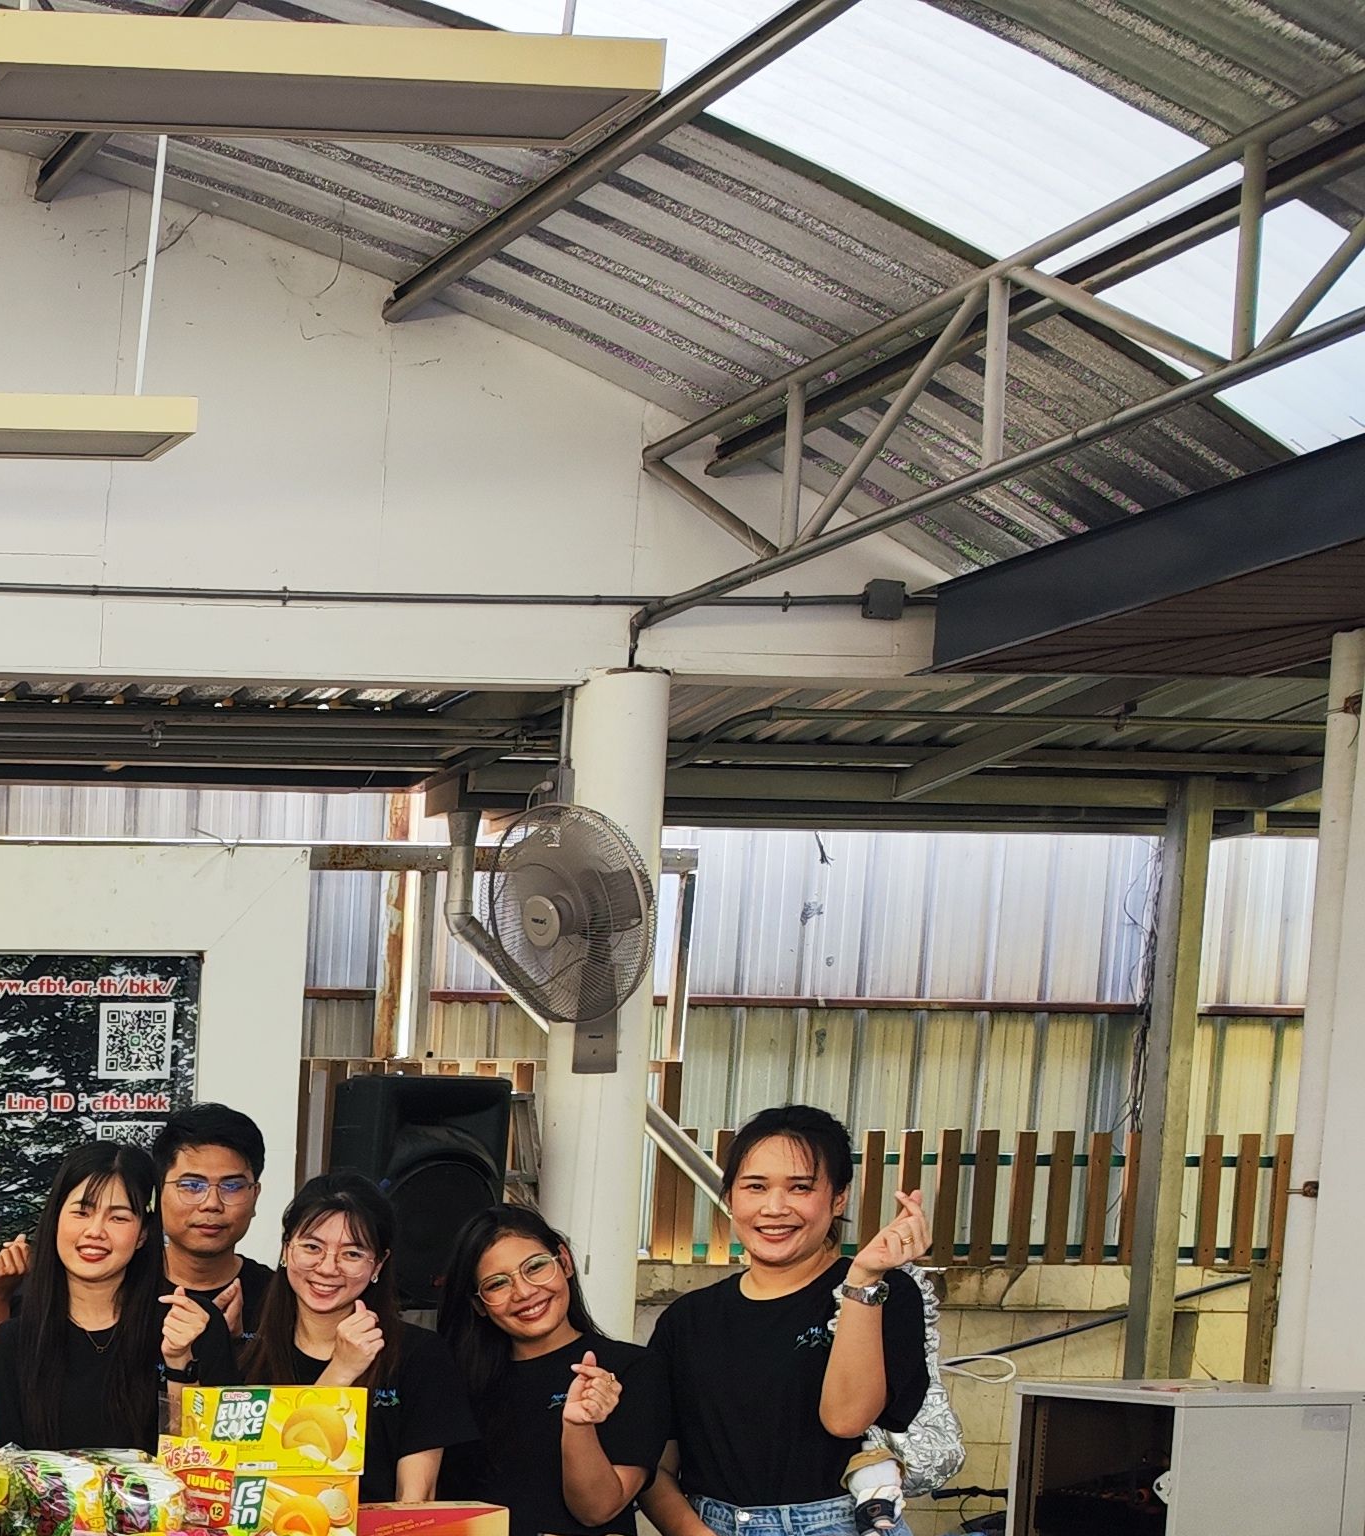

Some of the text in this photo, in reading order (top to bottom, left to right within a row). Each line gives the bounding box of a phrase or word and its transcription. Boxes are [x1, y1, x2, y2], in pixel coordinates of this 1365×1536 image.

[6, 1092, 170, 1113] Line ID cfbt.bkk
[217, 1400, 267, 1421] EURO
[214, 1418, 264, 1439] CAKE
